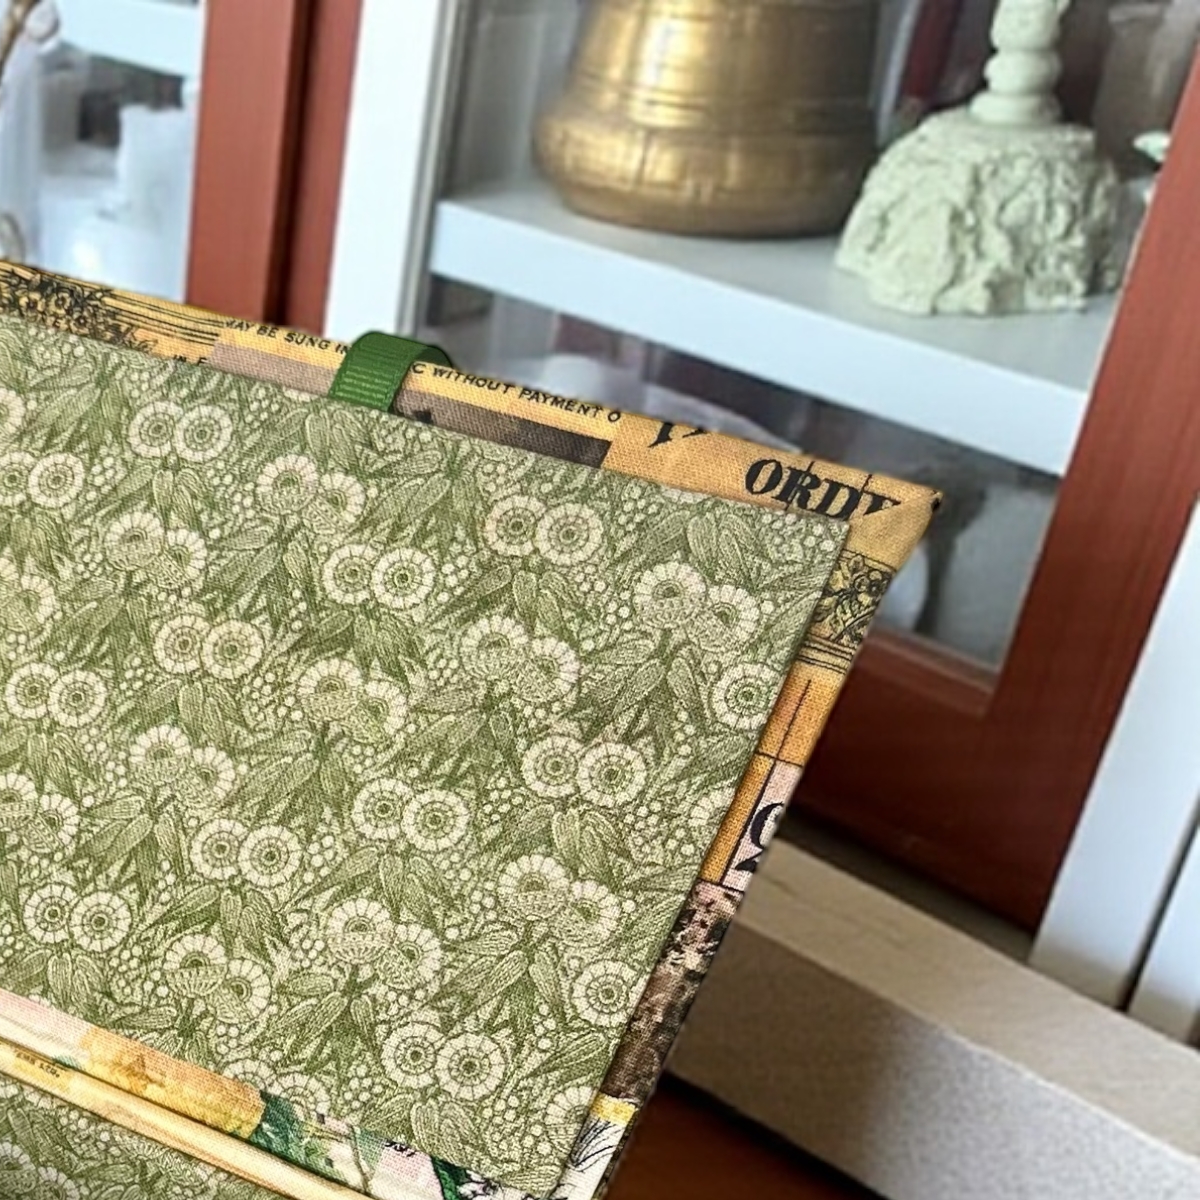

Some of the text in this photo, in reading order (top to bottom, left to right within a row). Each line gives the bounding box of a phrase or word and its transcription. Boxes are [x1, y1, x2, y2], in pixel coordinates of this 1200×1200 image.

[257, 324, 279, 339] BE
[283, 331, 333, 353] SUNG
[431, 365, 513, 395] WITHOUT
[518, 385, 602, 421] PAYMENT
